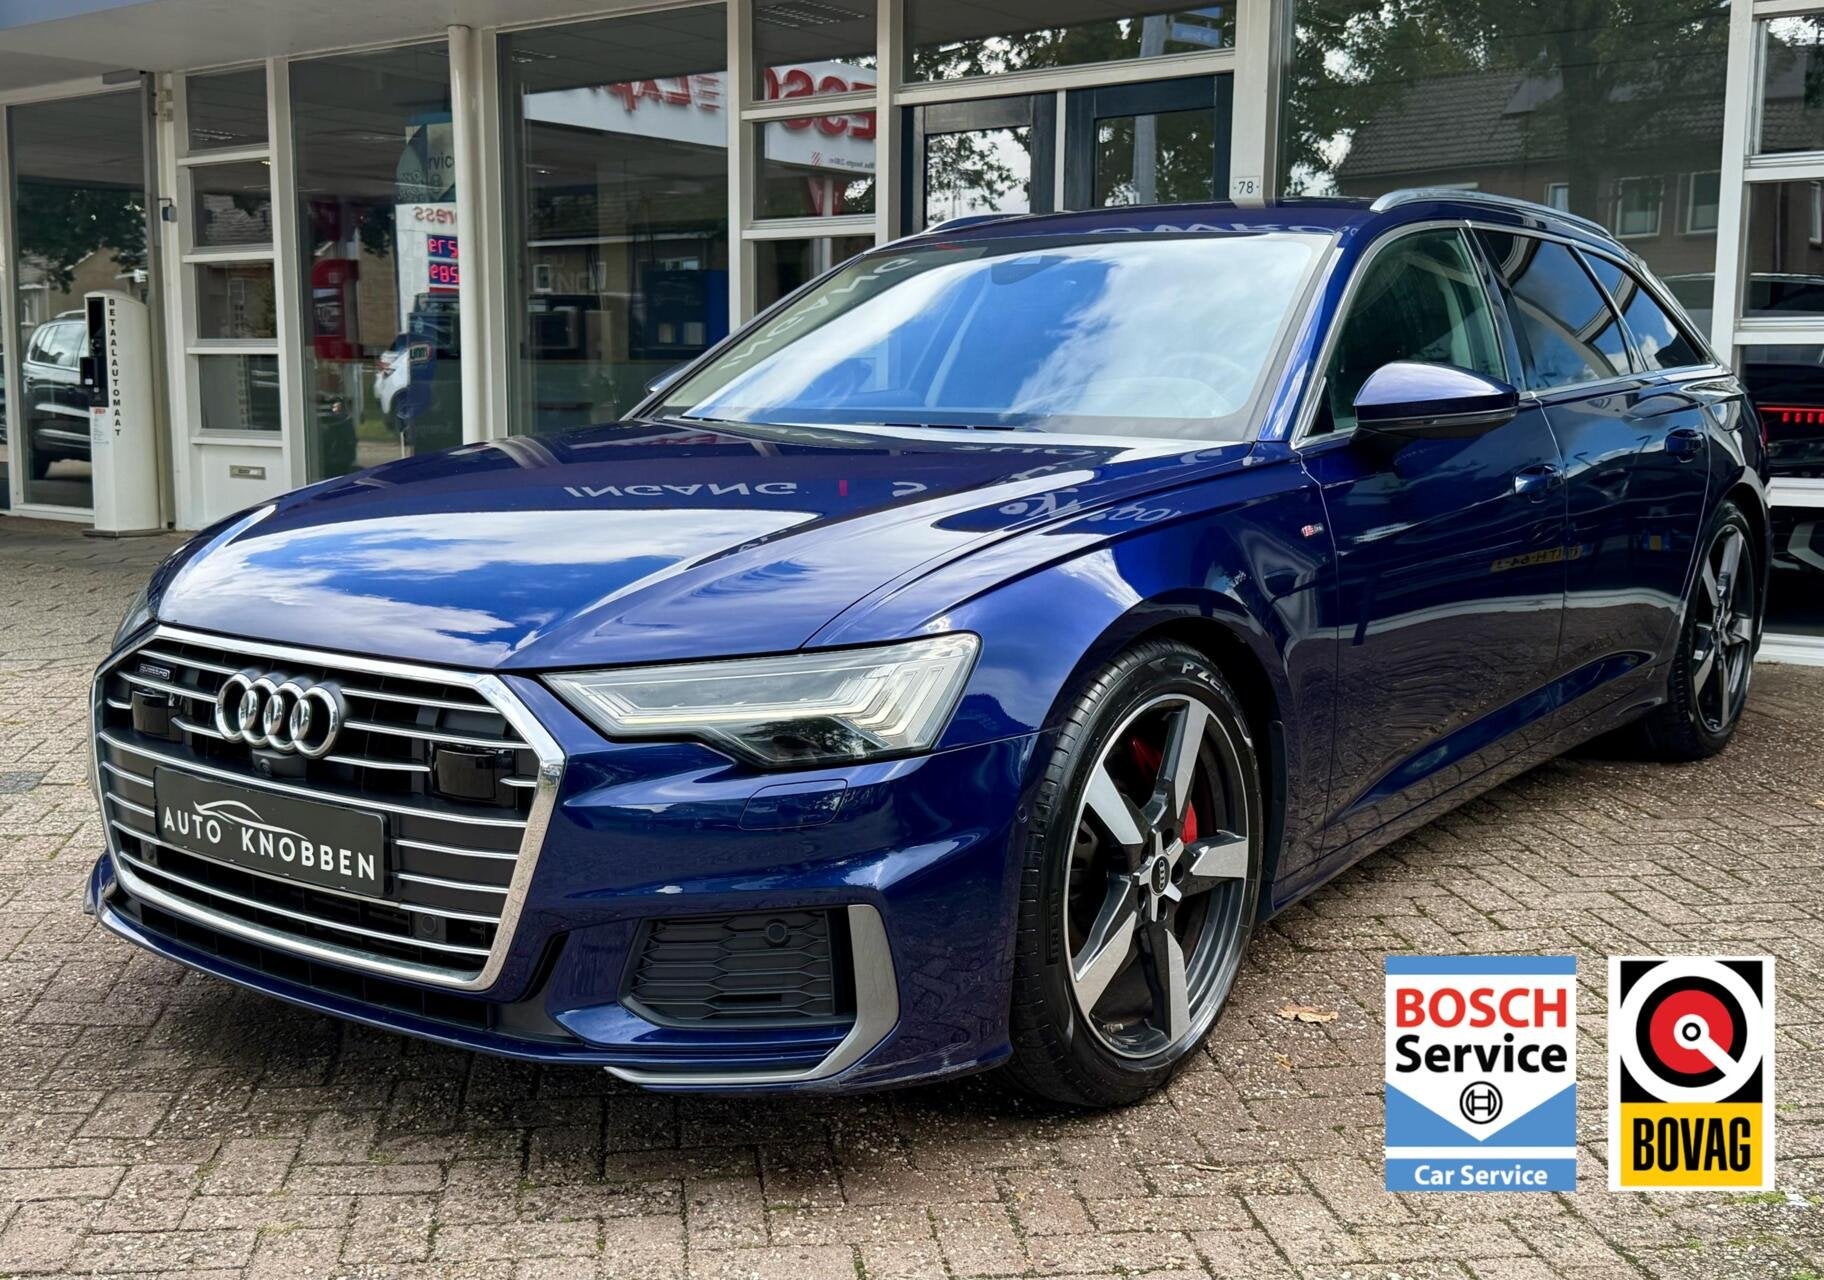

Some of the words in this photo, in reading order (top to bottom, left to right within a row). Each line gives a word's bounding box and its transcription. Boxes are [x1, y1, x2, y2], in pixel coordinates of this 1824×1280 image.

[1238, 181, 1254, 194] 78
[108, 298, 121, 436] BETAALAUTOMAAT
[164, 806, 222, 844] AUTO
[241, 826, 375, 881] KNOBBEN
